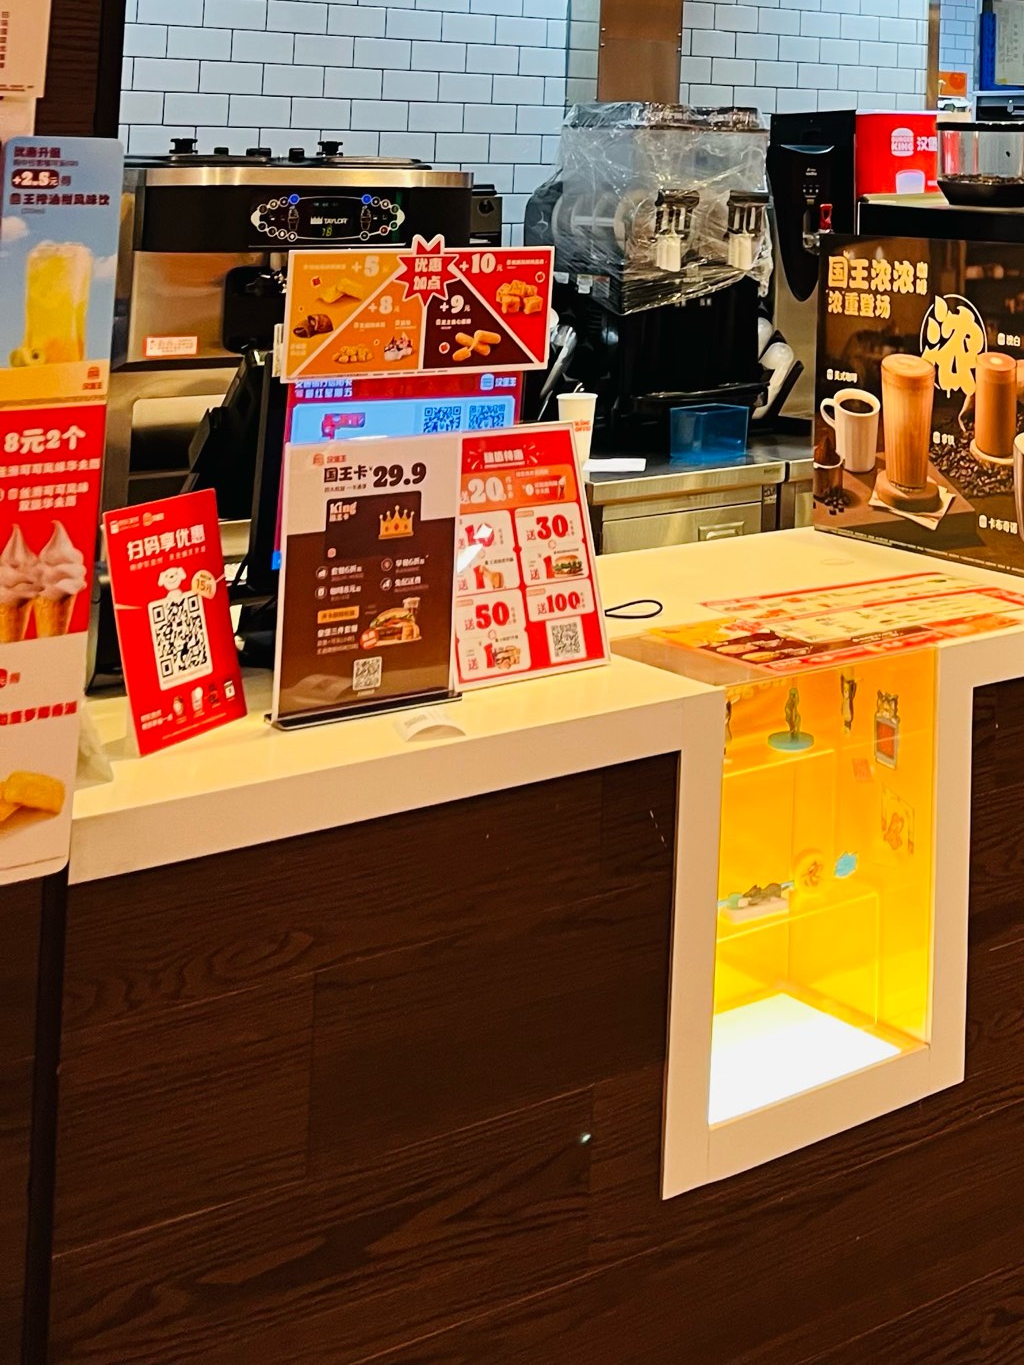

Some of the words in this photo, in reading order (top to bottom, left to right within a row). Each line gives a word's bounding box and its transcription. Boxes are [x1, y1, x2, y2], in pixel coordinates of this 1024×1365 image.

[891, 141, 914, 152] KING
[414, 257, 442, 273] 优惠
[413, 275, 441, 291] 加点
[3, 425, 87, 454] 8元2个
[327, 455, 347, 464] 汉堡王
[324, 464, 368, 483] 国王卡
[329, 501, 357, 516] King
[127, 524, 205, 561] 扫码享优惠
